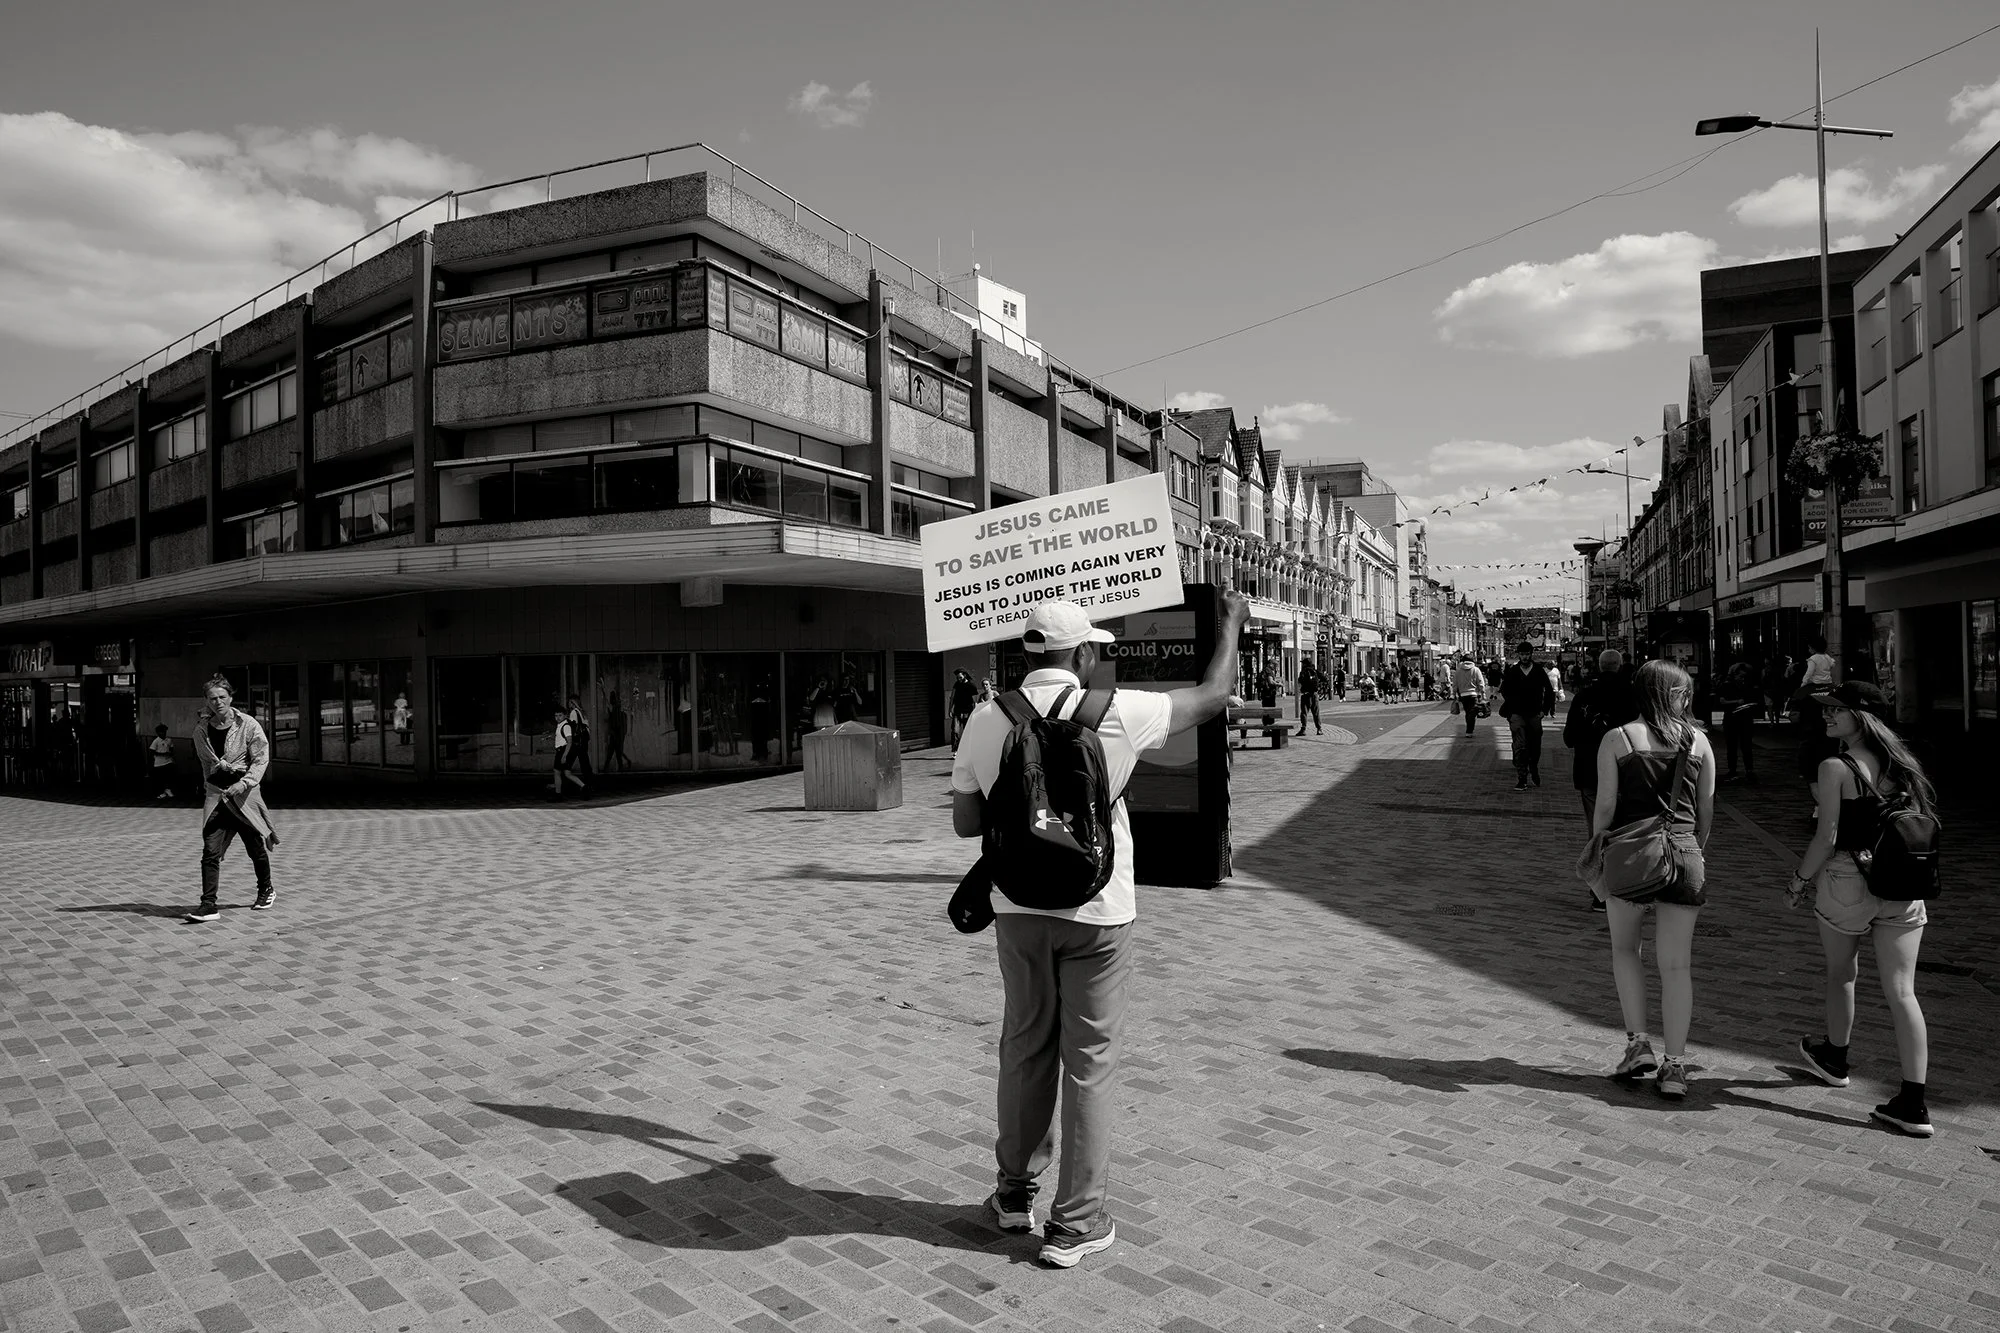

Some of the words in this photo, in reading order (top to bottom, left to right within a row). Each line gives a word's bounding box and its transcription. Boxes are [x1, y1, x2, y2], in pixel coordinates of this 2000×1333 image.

[634, 309, 669, 329] 777
[975, 512, 1042, 540] JESUS
[1048, 498, 1110, 523] CAME
[935, 558, 962, 577] TO
[969, 543, 1023, 569] SAVE
[1028, 534, 1073, 555] THE
[1078, 517, 1157, 545] WORLD
[934, 582, 982, 603] JESUS
[986, 578, 1000, 592] IS
[1004, 564, 1066, 587] COMING
[1071, 553, 1120, 573] AGAIN
[1124, 544, 1166, 563] VERY
[943, 602, 985, 621] SOON
[988, 597, 1009, 611] TO
[1012, 584, 1066, 606] JUDGE
[1069, 577, 1102, 594] THE
[1105, 567, 1162, 588] WORLD
[969, 617, 993, 630] GET
[1099, 588, 1141, 604] JESUS
[8, 647, 44, 673] CORAL
[1106, 642, 1157, 657] Could
[1161, 644, 1195, 659] you
